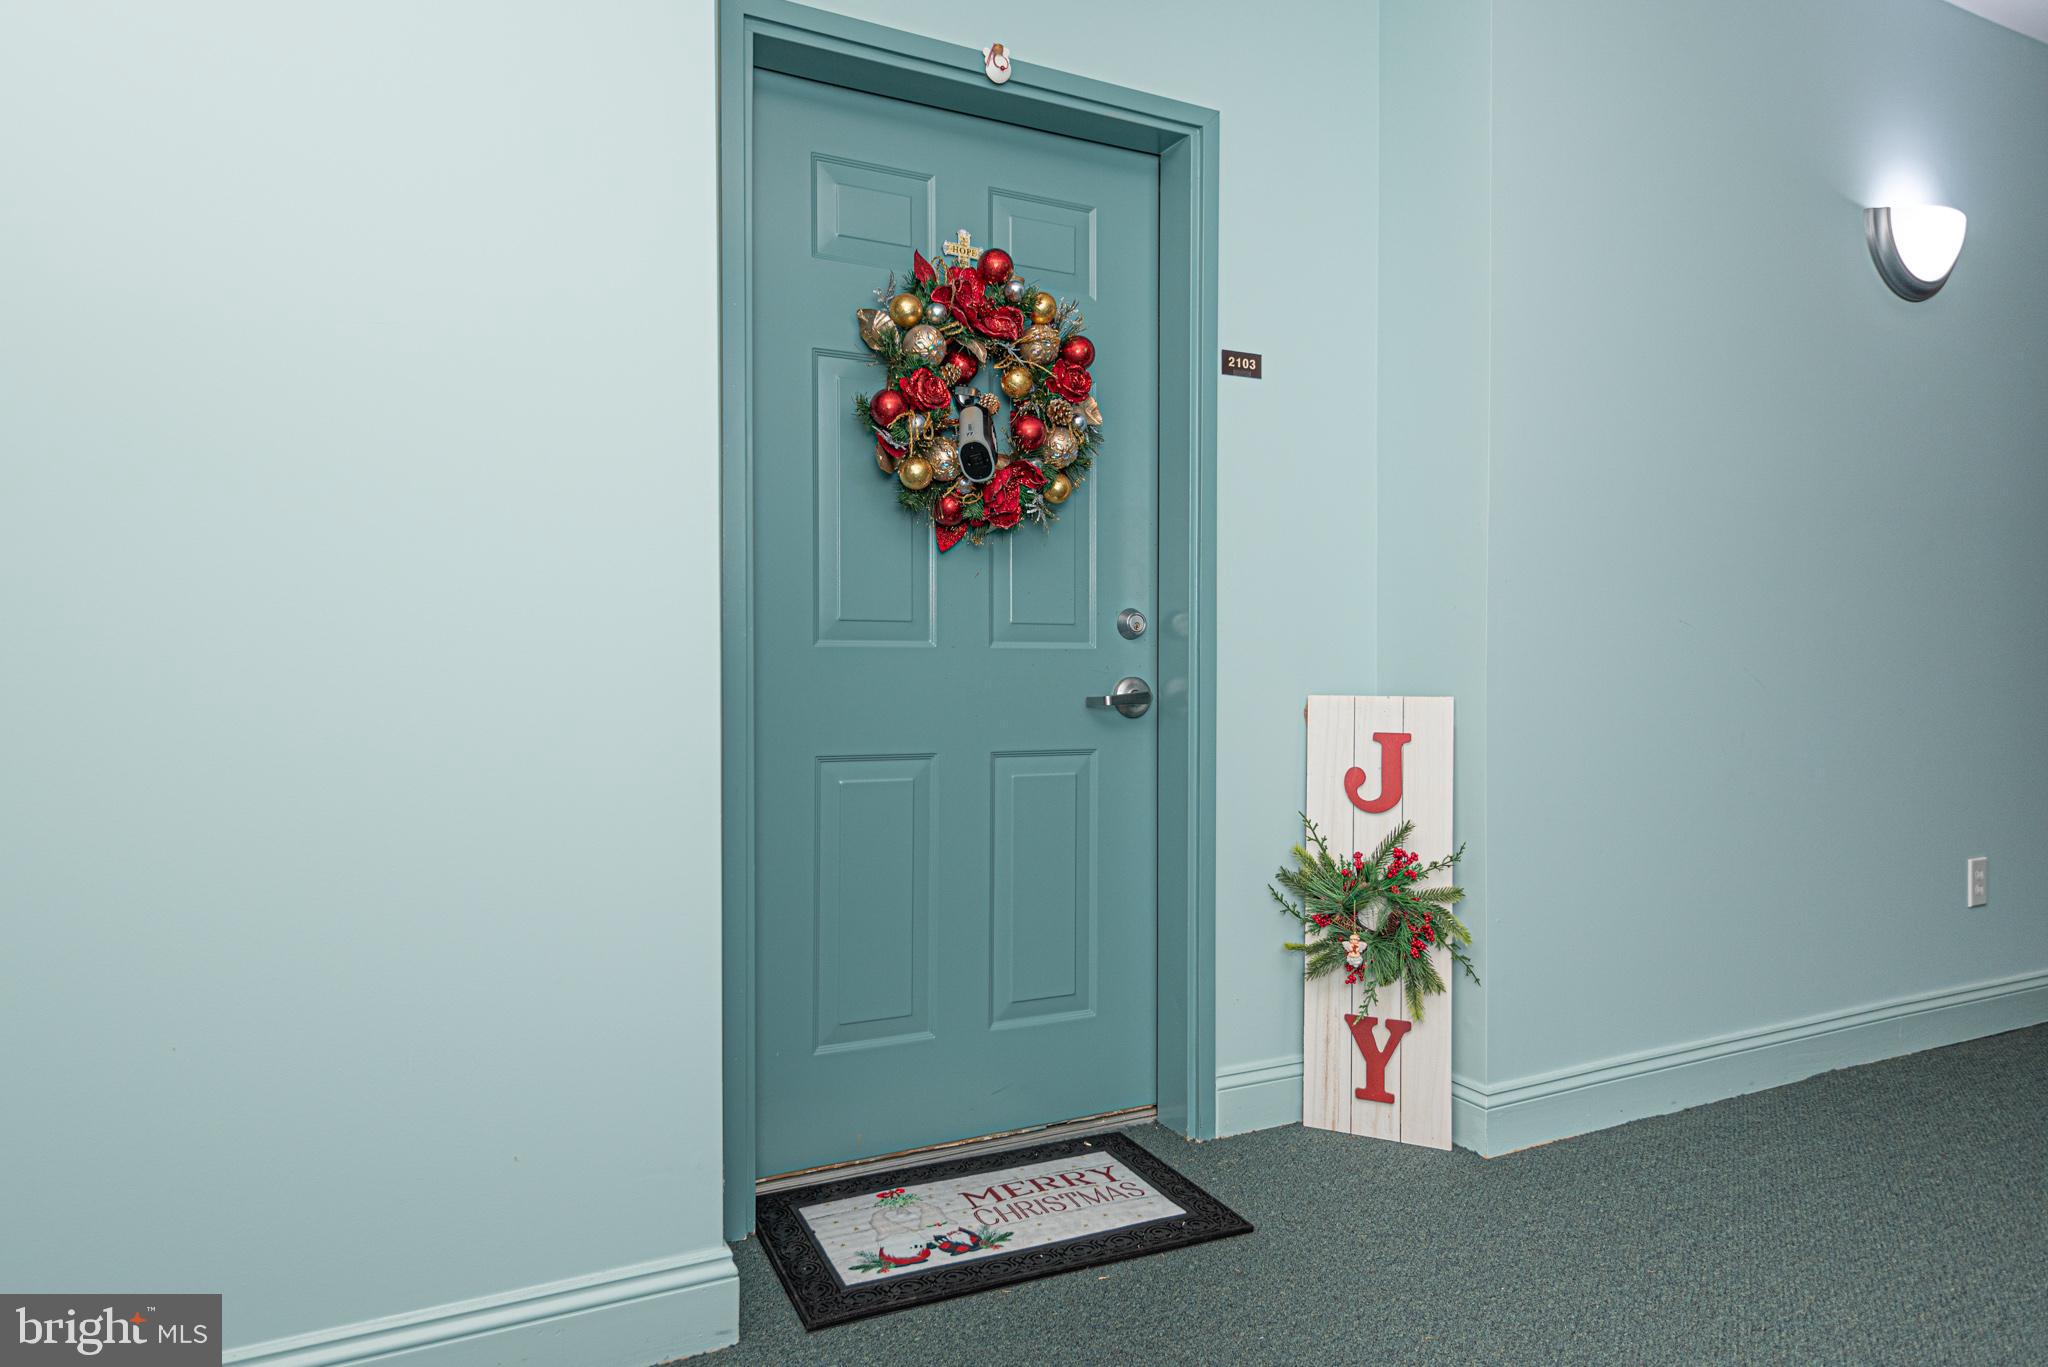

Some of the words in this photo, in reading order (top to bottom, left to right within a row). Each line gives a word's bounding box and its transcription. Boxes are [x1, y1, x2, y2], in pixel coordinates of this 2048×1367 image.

[952, 244, 978, 257] HOPE
[1228, 356, 1257, 370] 2103
[958, 1164, 1122, 1210] MERRY
[973, 1181, 1146, 1227] CHRISTMAS
